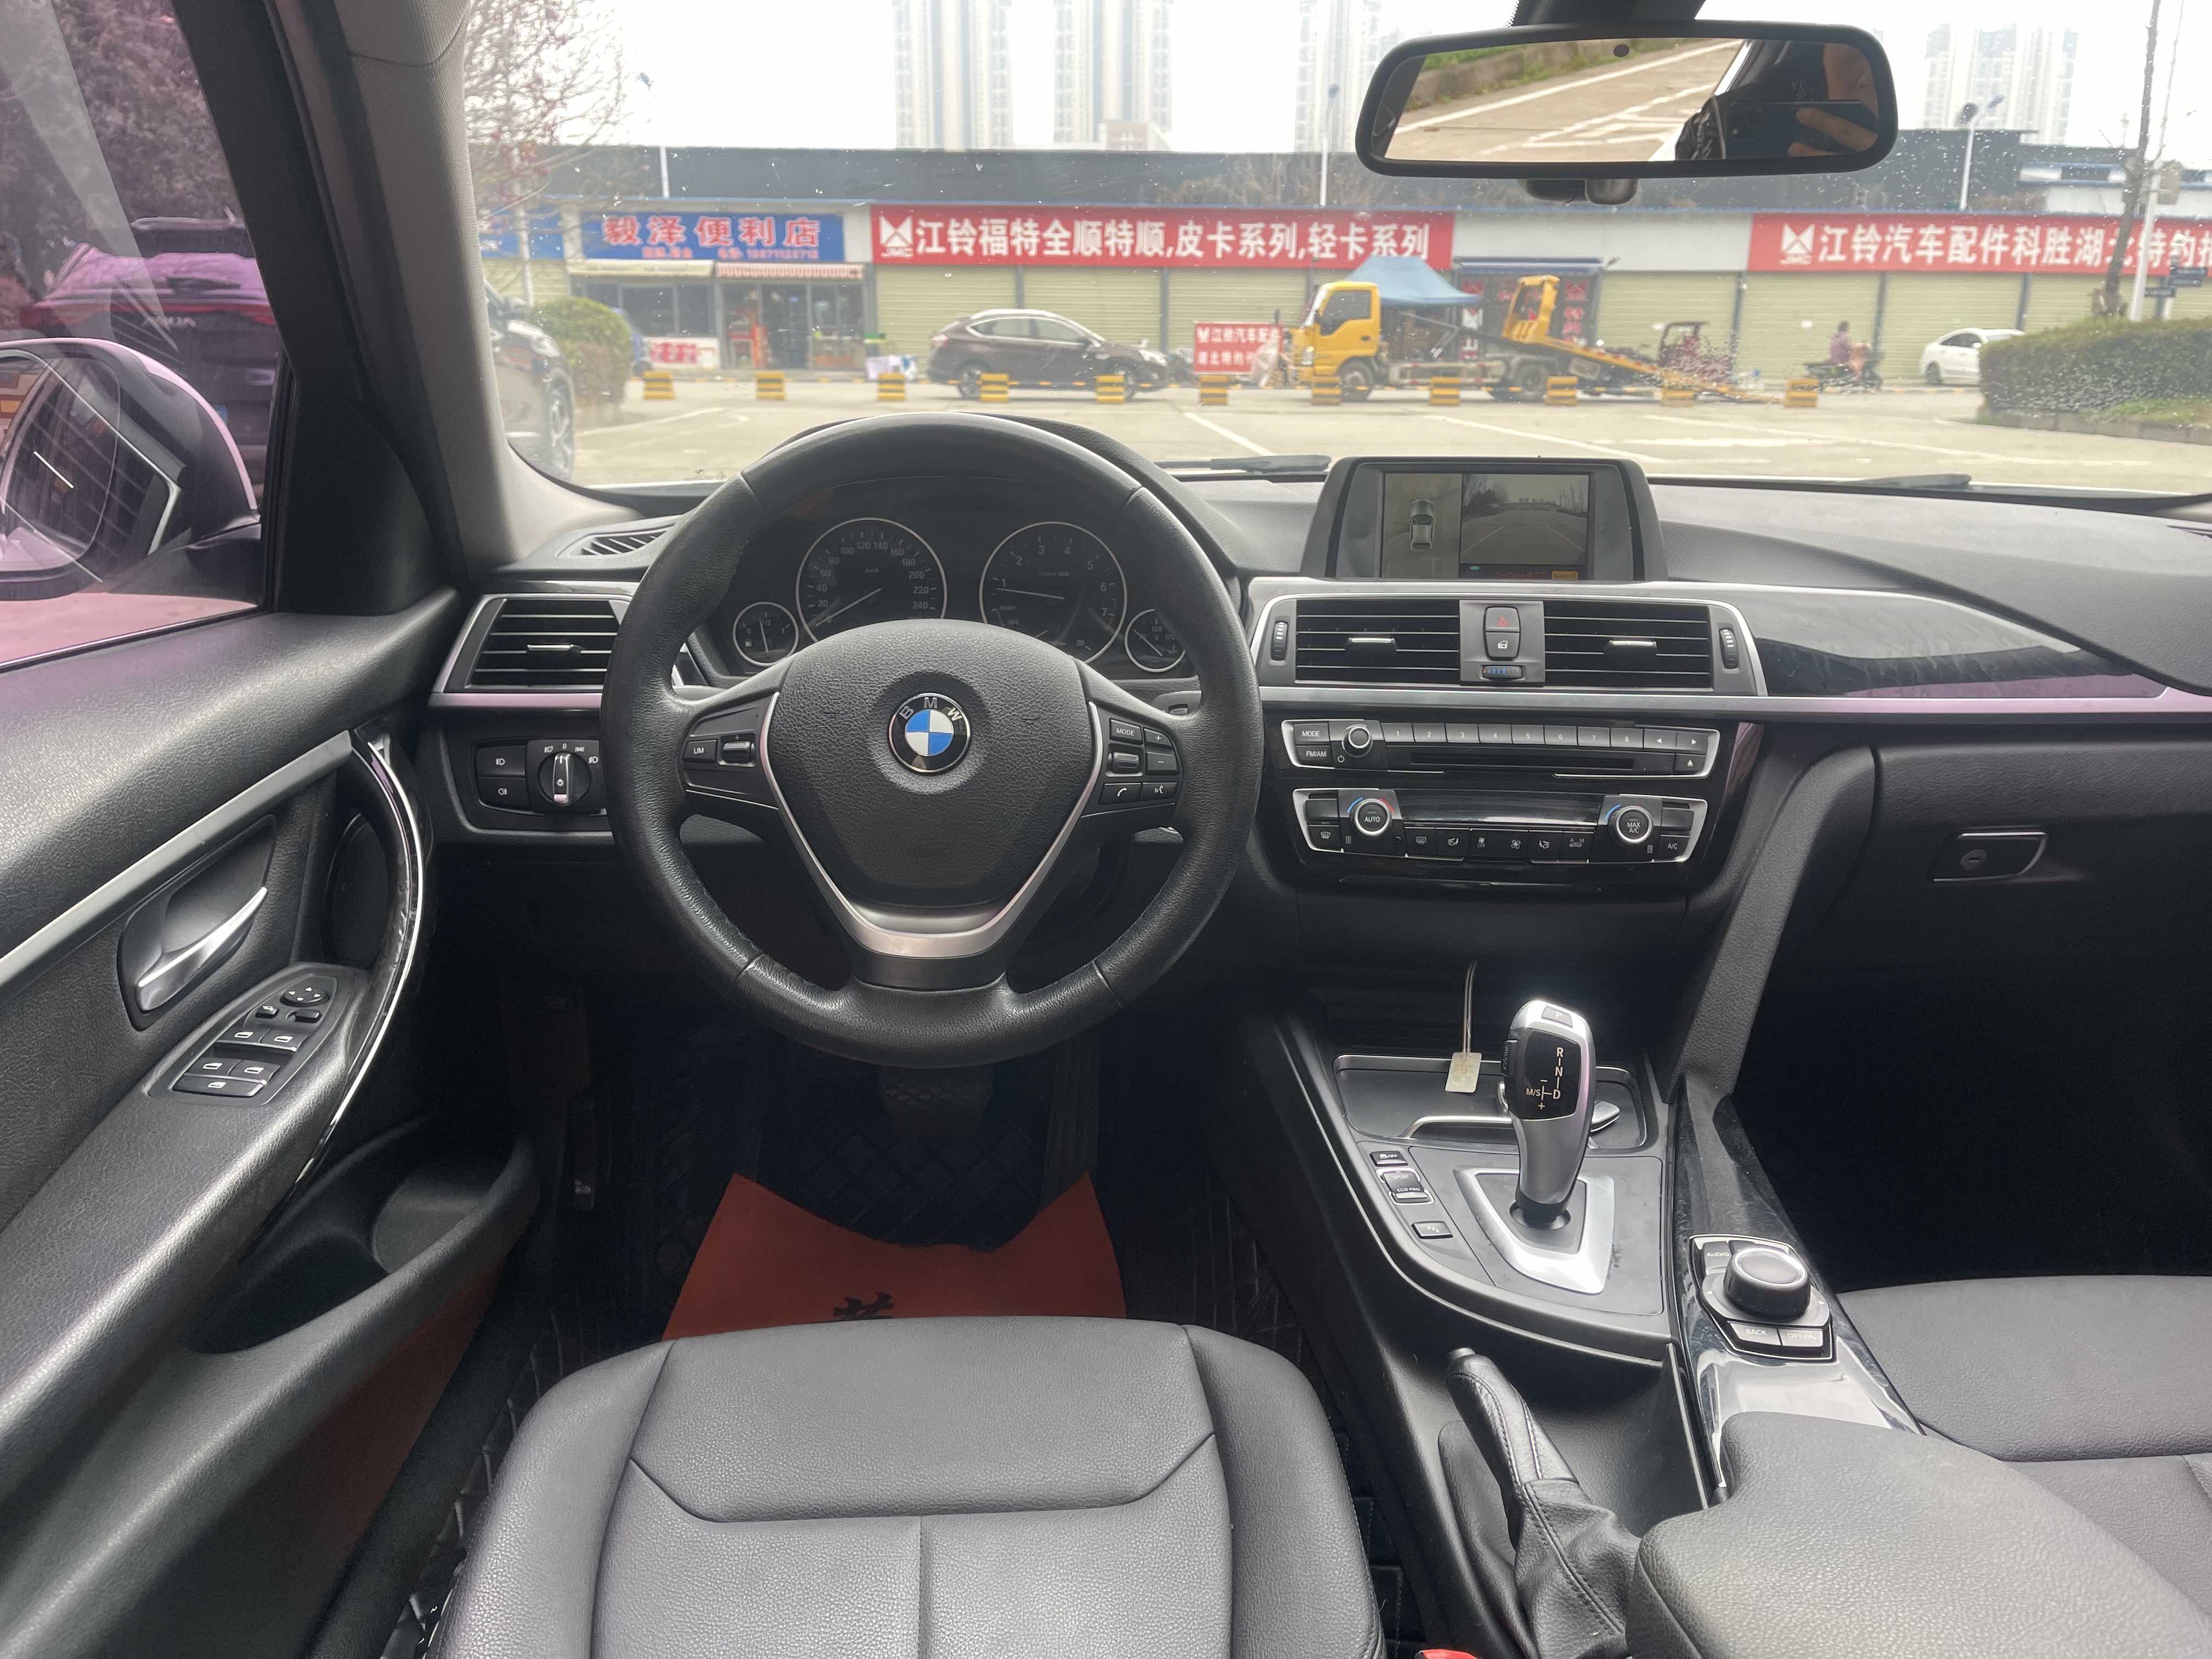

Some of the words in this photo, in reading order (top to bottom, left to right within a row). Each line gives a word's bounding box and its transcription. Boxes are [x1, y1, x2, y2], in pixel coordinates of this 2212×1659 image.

[1039, 546, 1045, 554] 3
[1064, 546, 1070, 555] 4
[1017, 556, 1022, 565] 2
[1087, 561, 1093, 570] 5
[1001, 578, 1006, 587] 1
[1101, 583, 1107, 591] 6
[818, 599, 828, 607] 20
[1102, 608, 1108, 617] 7
[899, 697, 963, 721] BMW
[1116, 727, 1136, 736] MODE
[693, 747, 704, 755] LIM
[1306, 750, 1327, 758] FM/AM
[1556, 1047, 1564, 1057] R
[1555, 1066, 1563, 1077] N
[1526, 1088, 1541, 1097] M/S
[1553, 1088, 1561, 1100] D
[1746, 1328, 1768, 1336] BACK
